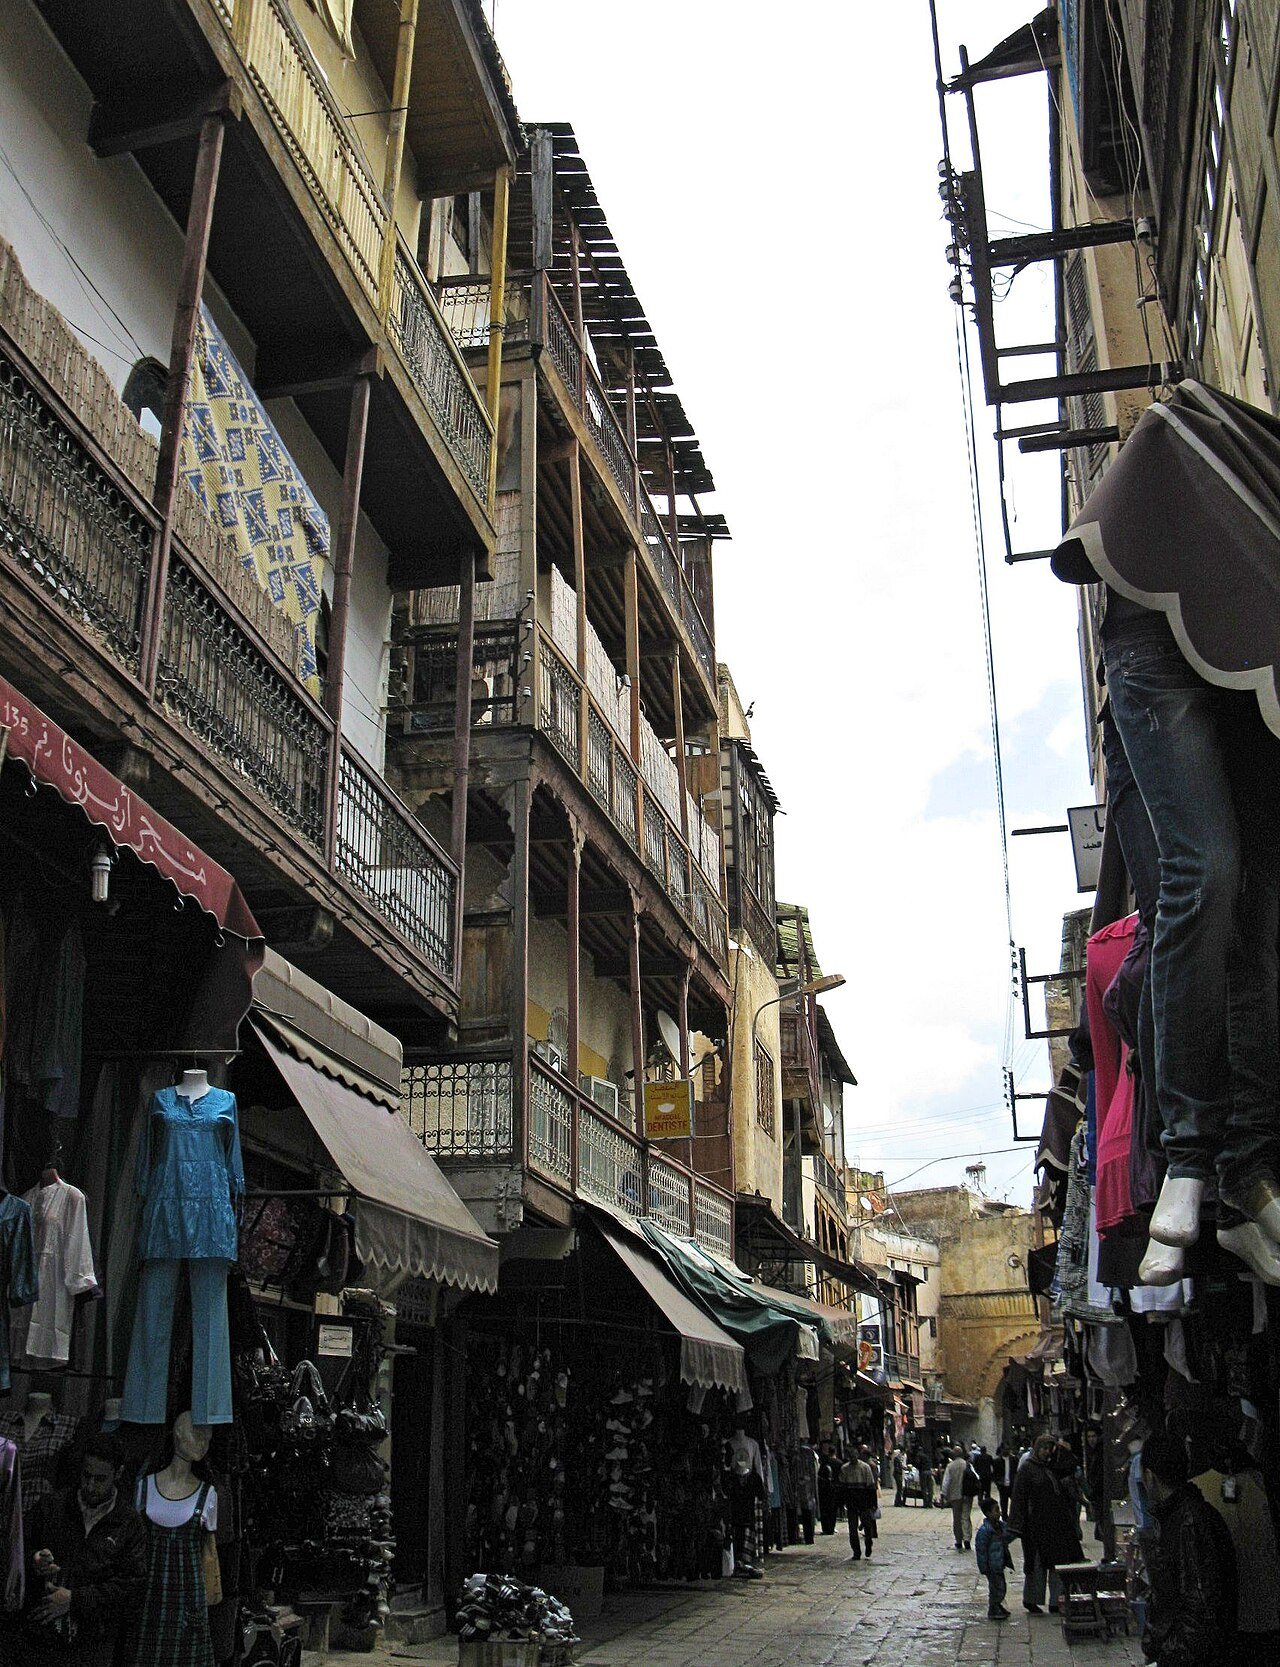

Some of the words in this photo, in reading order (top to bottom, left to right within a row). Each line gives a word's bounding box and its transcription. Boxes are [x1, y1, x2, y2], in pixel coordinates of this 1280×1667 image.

[4, 701, 28, 735] 135
[131, 815, 207, 885] متجر
[647, 1120, 688, 1132] DENTISTE
